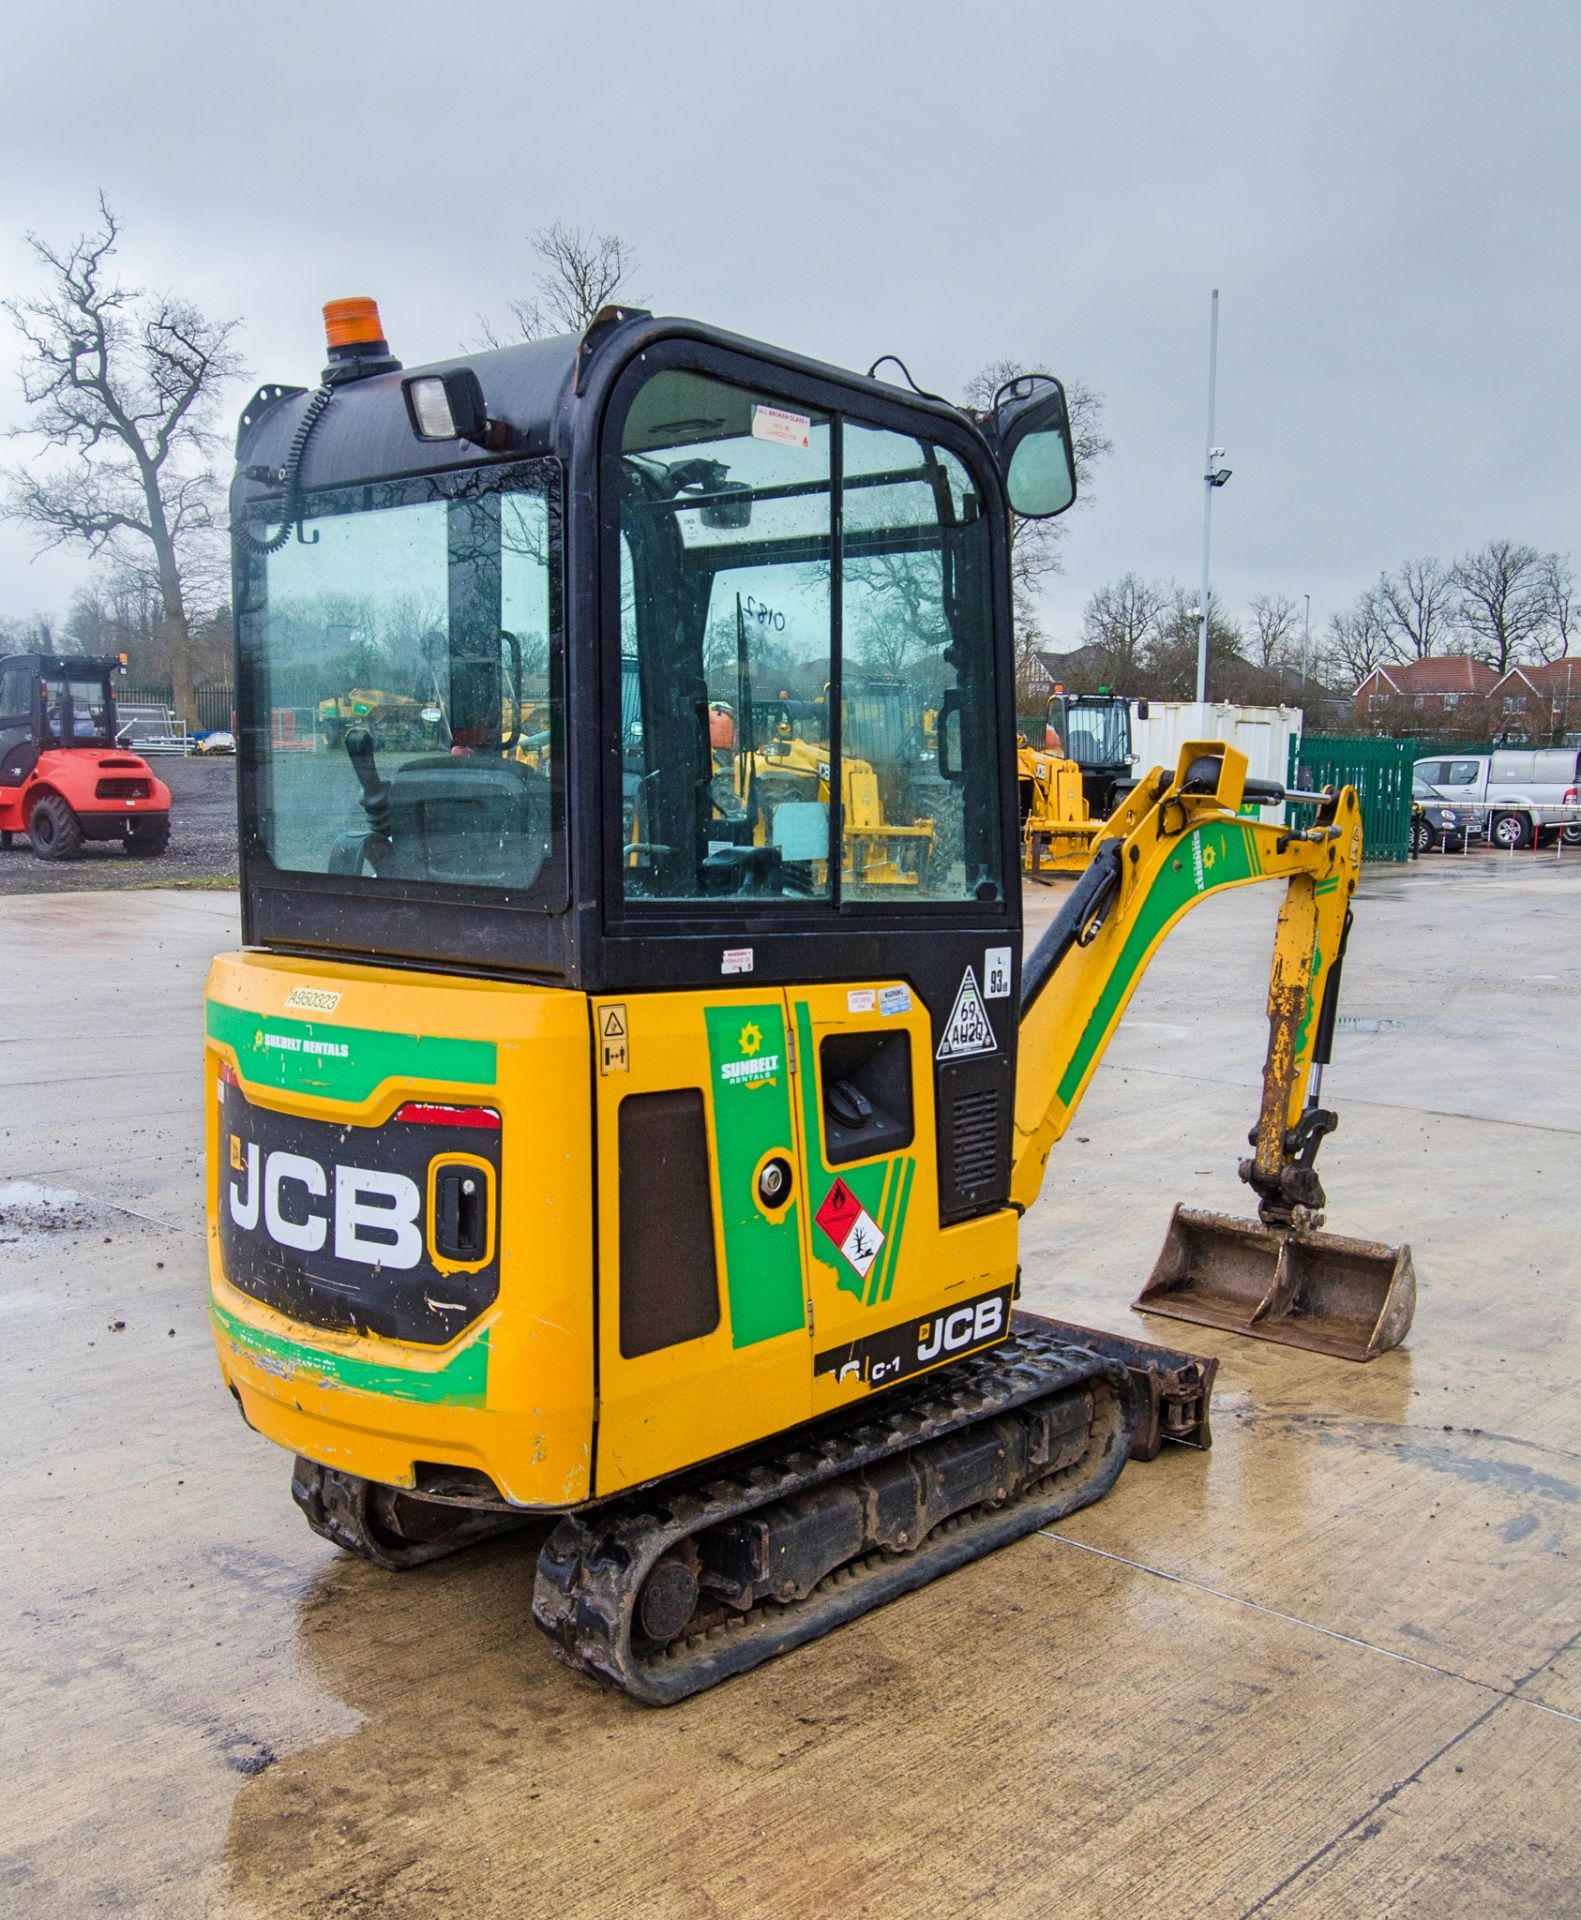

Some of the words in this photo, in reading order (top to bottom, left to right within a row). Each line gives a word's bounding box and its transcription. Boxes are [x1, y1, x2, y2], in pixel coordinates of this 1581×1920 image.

[990, 970, 1003, 993] 93
[288, 990, 338, 1010] A950323
[961, 1001, 976, 1022] 69
[264, 1033, 302, 1052] SUNBELT
[302, 1040, 349, 1058] RENTALS
[721, 1054, 779, 1080] SUNBELT
[729, 1071, 771, 1085] RENTALS
[229, 1141, 422, 1270] JCB
[917, 1296, 1003, 1361] JCB
[872, 1355, 901, 1380] C-1
